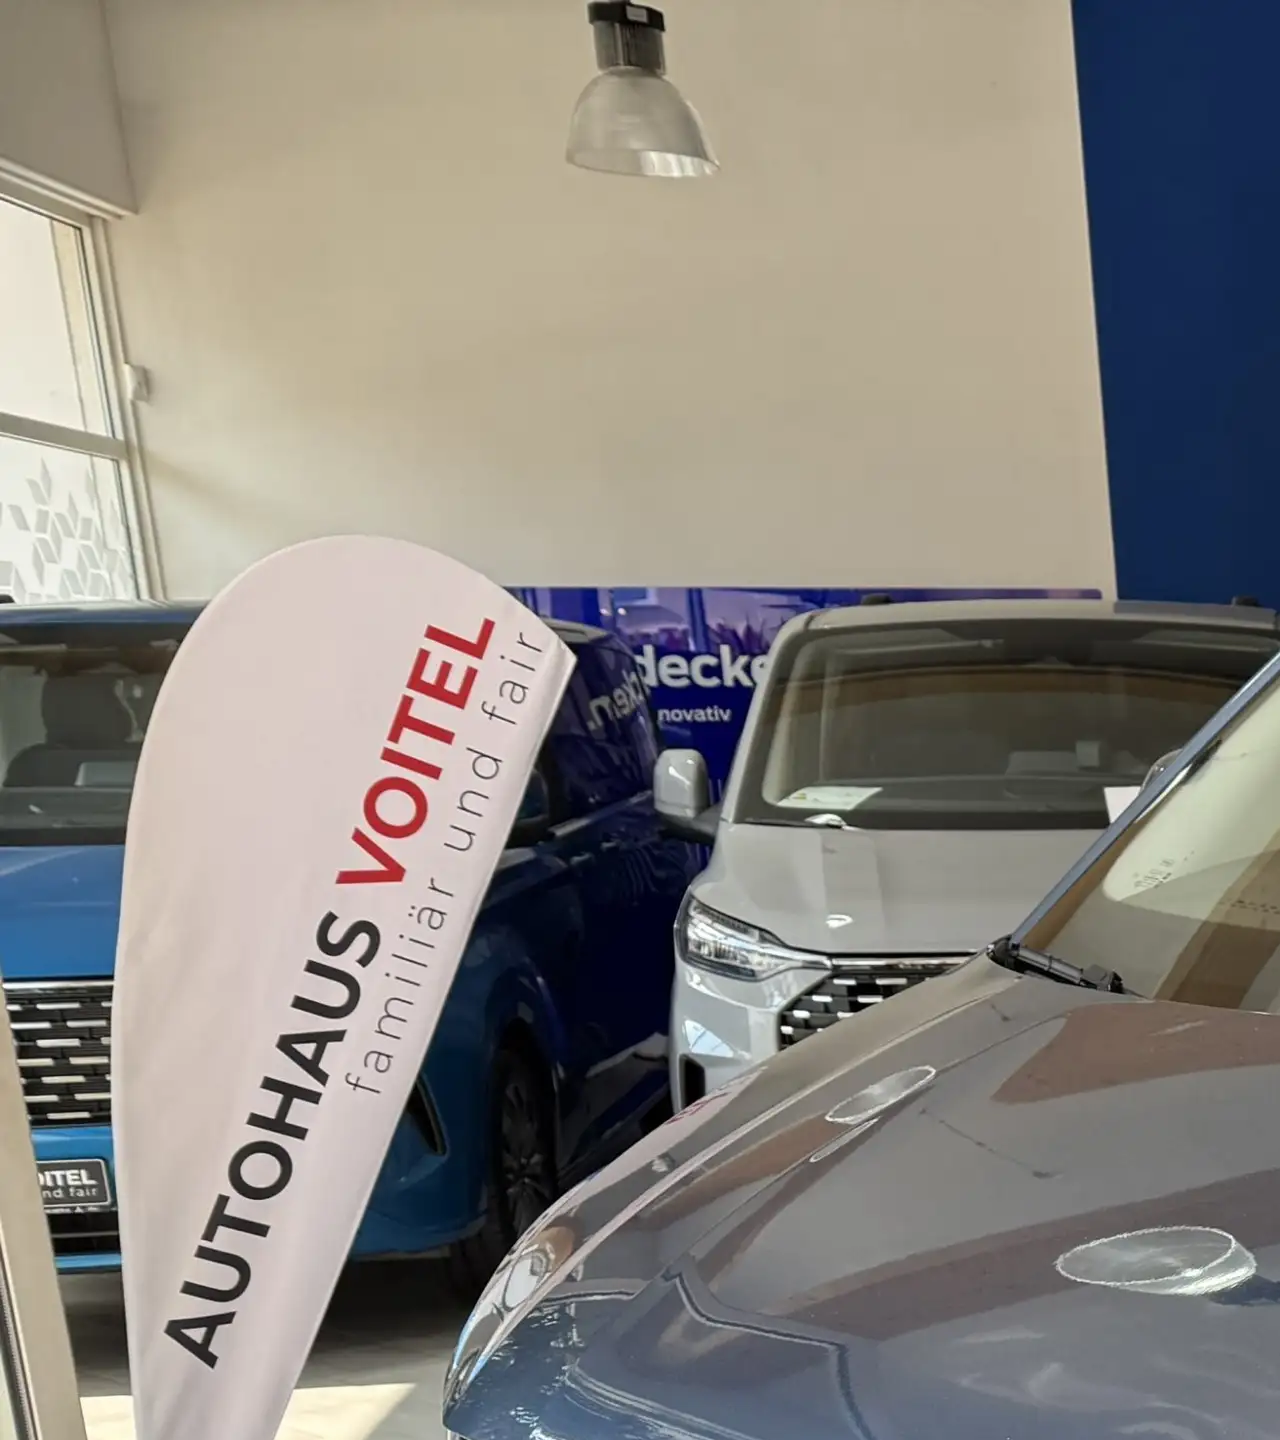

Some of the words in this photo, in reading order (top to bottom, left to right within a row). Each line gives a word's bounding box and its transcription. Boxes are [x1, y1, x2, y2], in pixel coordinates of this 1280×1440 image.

[163, 910, 381, 1370] AUTOHAUS
[335, 618, 496, 886] VOITEL
[345, 877, 455, 1094] familiär
[443, 747, 505, 853] und
[480, 631, 544, 725] fair
